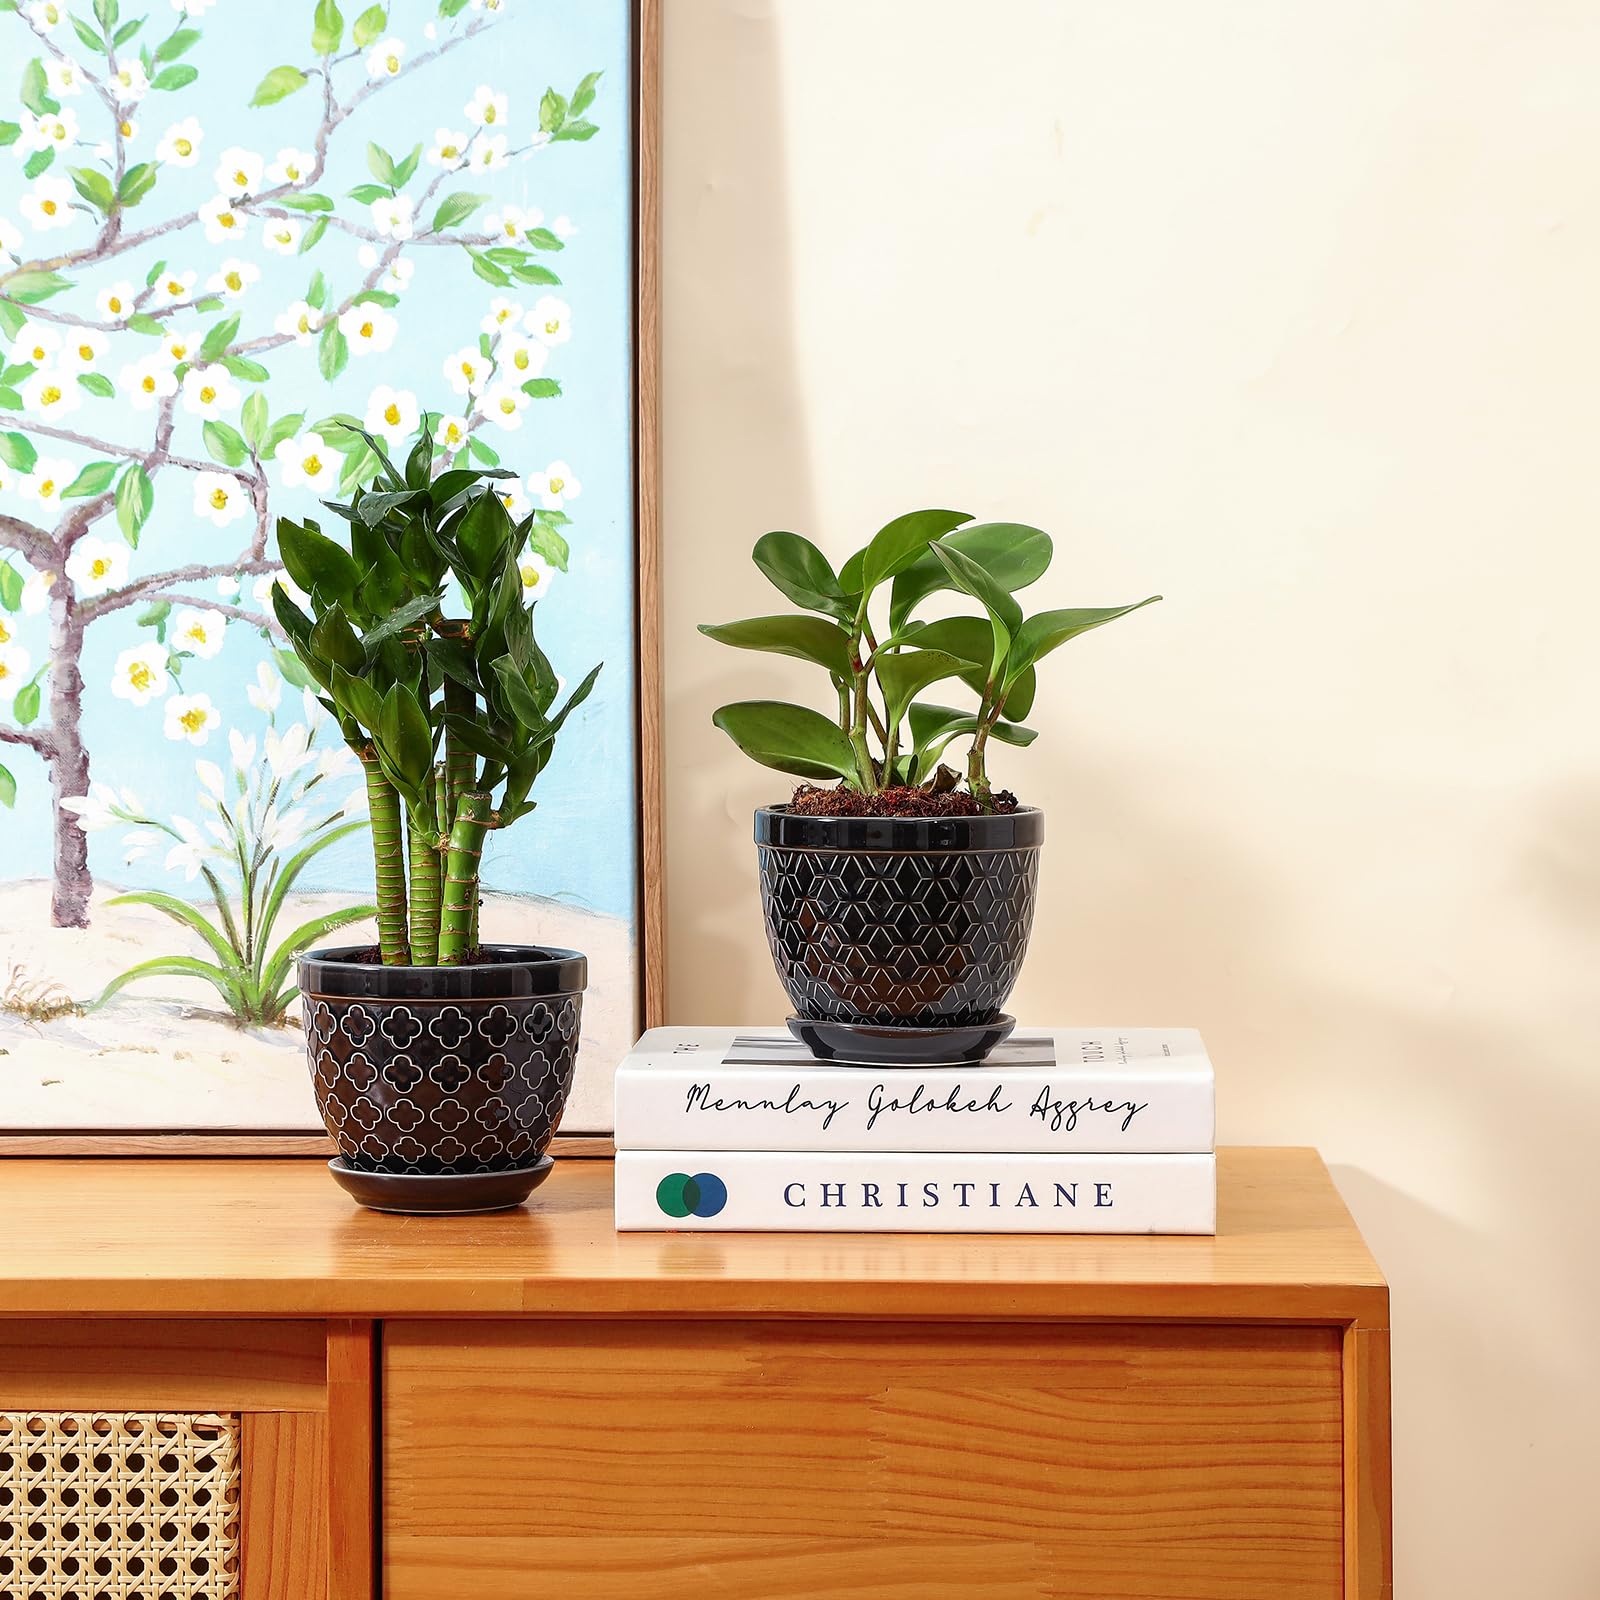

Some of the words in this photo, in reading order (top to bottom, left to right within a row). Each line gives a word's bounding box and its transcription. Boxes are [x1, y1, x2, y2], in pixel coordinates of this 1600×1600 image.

[1081, 1041, 1105, 1063] TOUCH
[686, 1084, 850, 1130] Mennlay
[867, 1084, 1013, 1130] Golokeh
[1029, 1085, 1149, 1132] Aggrey
[783, 1182, 1114, 1208] CHRISTIANE
